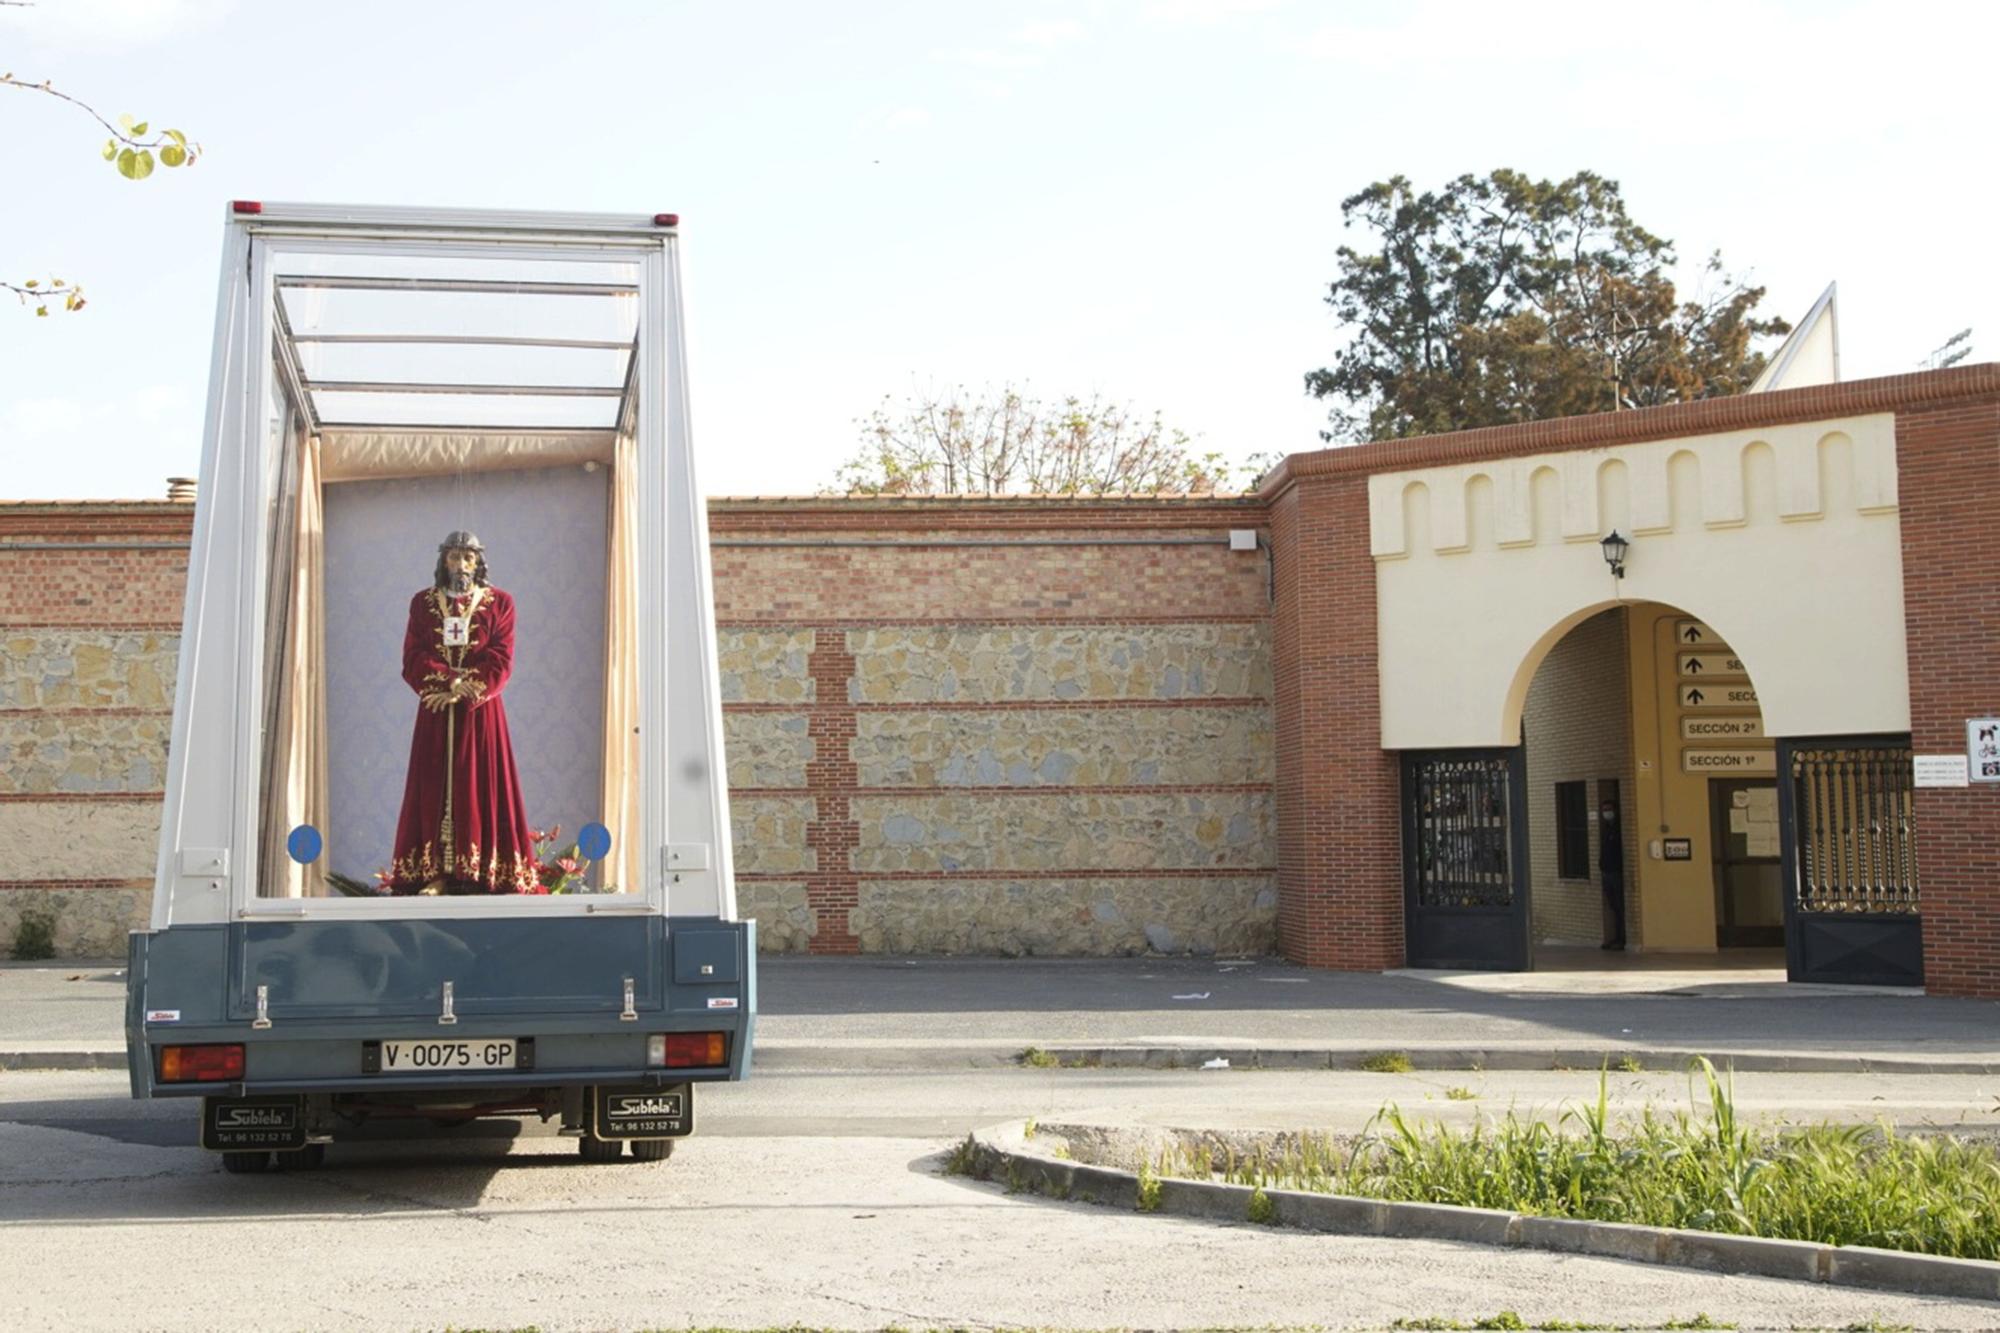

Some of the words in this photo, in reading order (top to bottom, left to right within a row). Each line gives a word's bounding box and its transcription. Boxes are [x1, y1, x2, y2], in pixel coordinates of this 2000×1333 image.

[1689, 722, 1739, 734] SECCIÓN
[1689, 754, 1740, 766] SECCIÓN
[610, 1098, 670, 1115] Subiela
[219, 1109, 282, 1126] Subiela
[640, 1122, 655, 1130] 132
